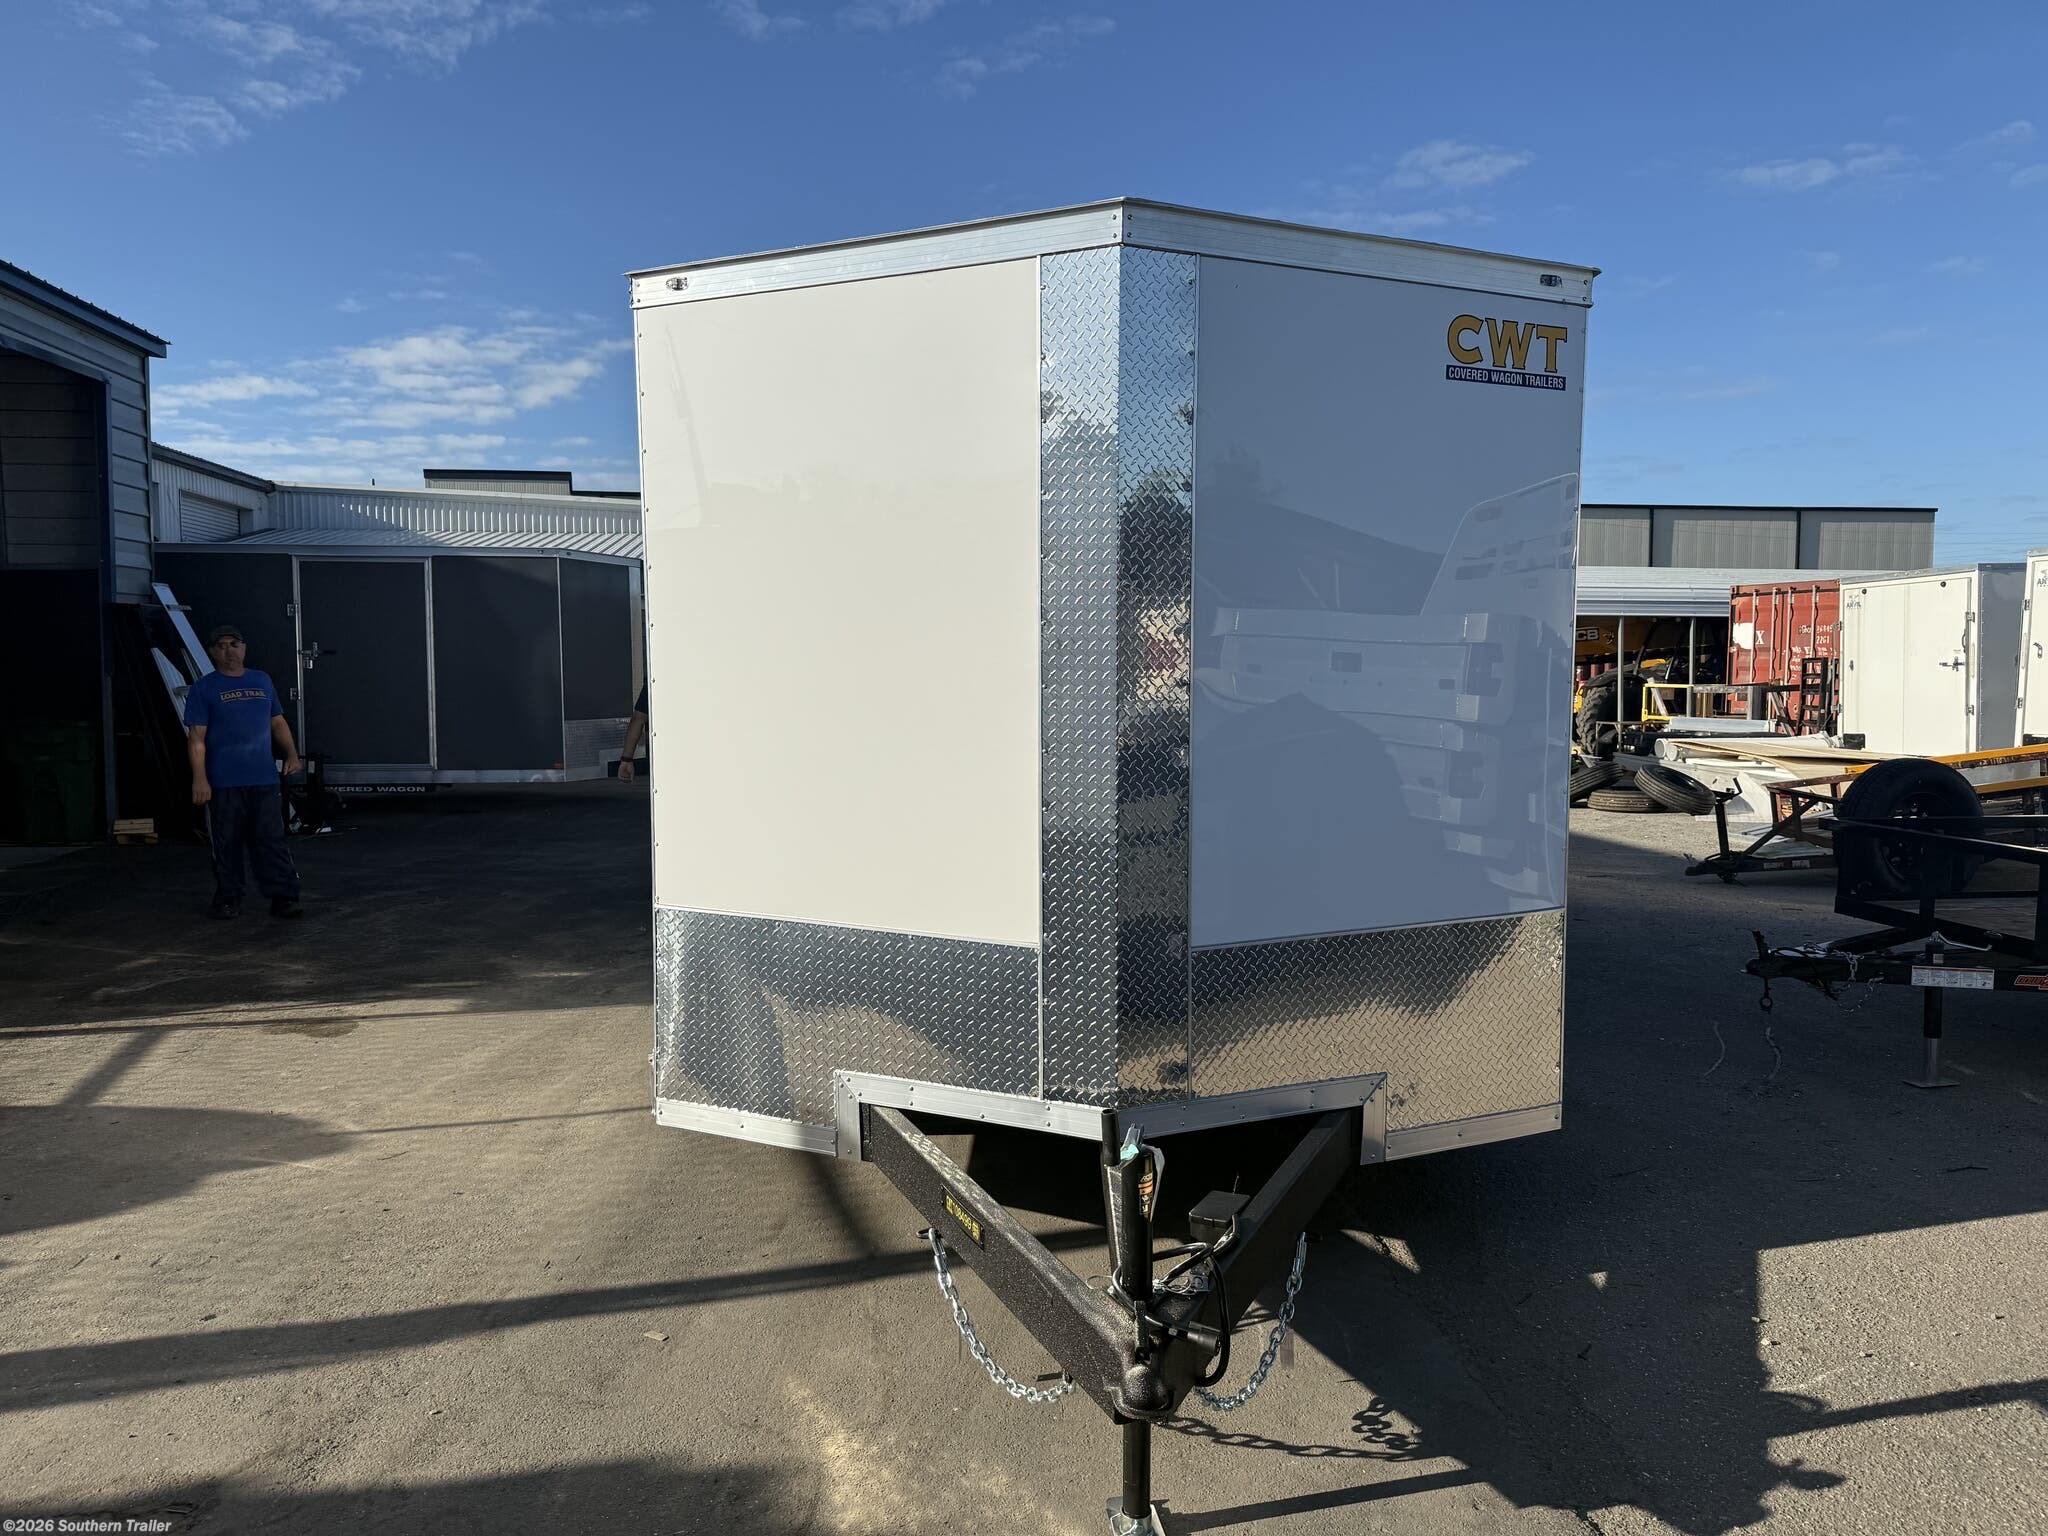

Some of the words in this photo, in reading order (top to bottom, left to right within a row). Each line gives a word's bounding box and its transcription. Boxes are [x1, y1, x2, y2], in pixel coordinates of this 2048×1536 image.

[1447, 314, 1568, 373] CWT
[1448, 366, 1489, 382] COVERED
[1490, 370, 1523, 385] WAGON
[1524, 374, 1564, 389] TRAILERS
[1576, 630, 1599, 640] CB
[220, 691, 242, 701] LOAD
